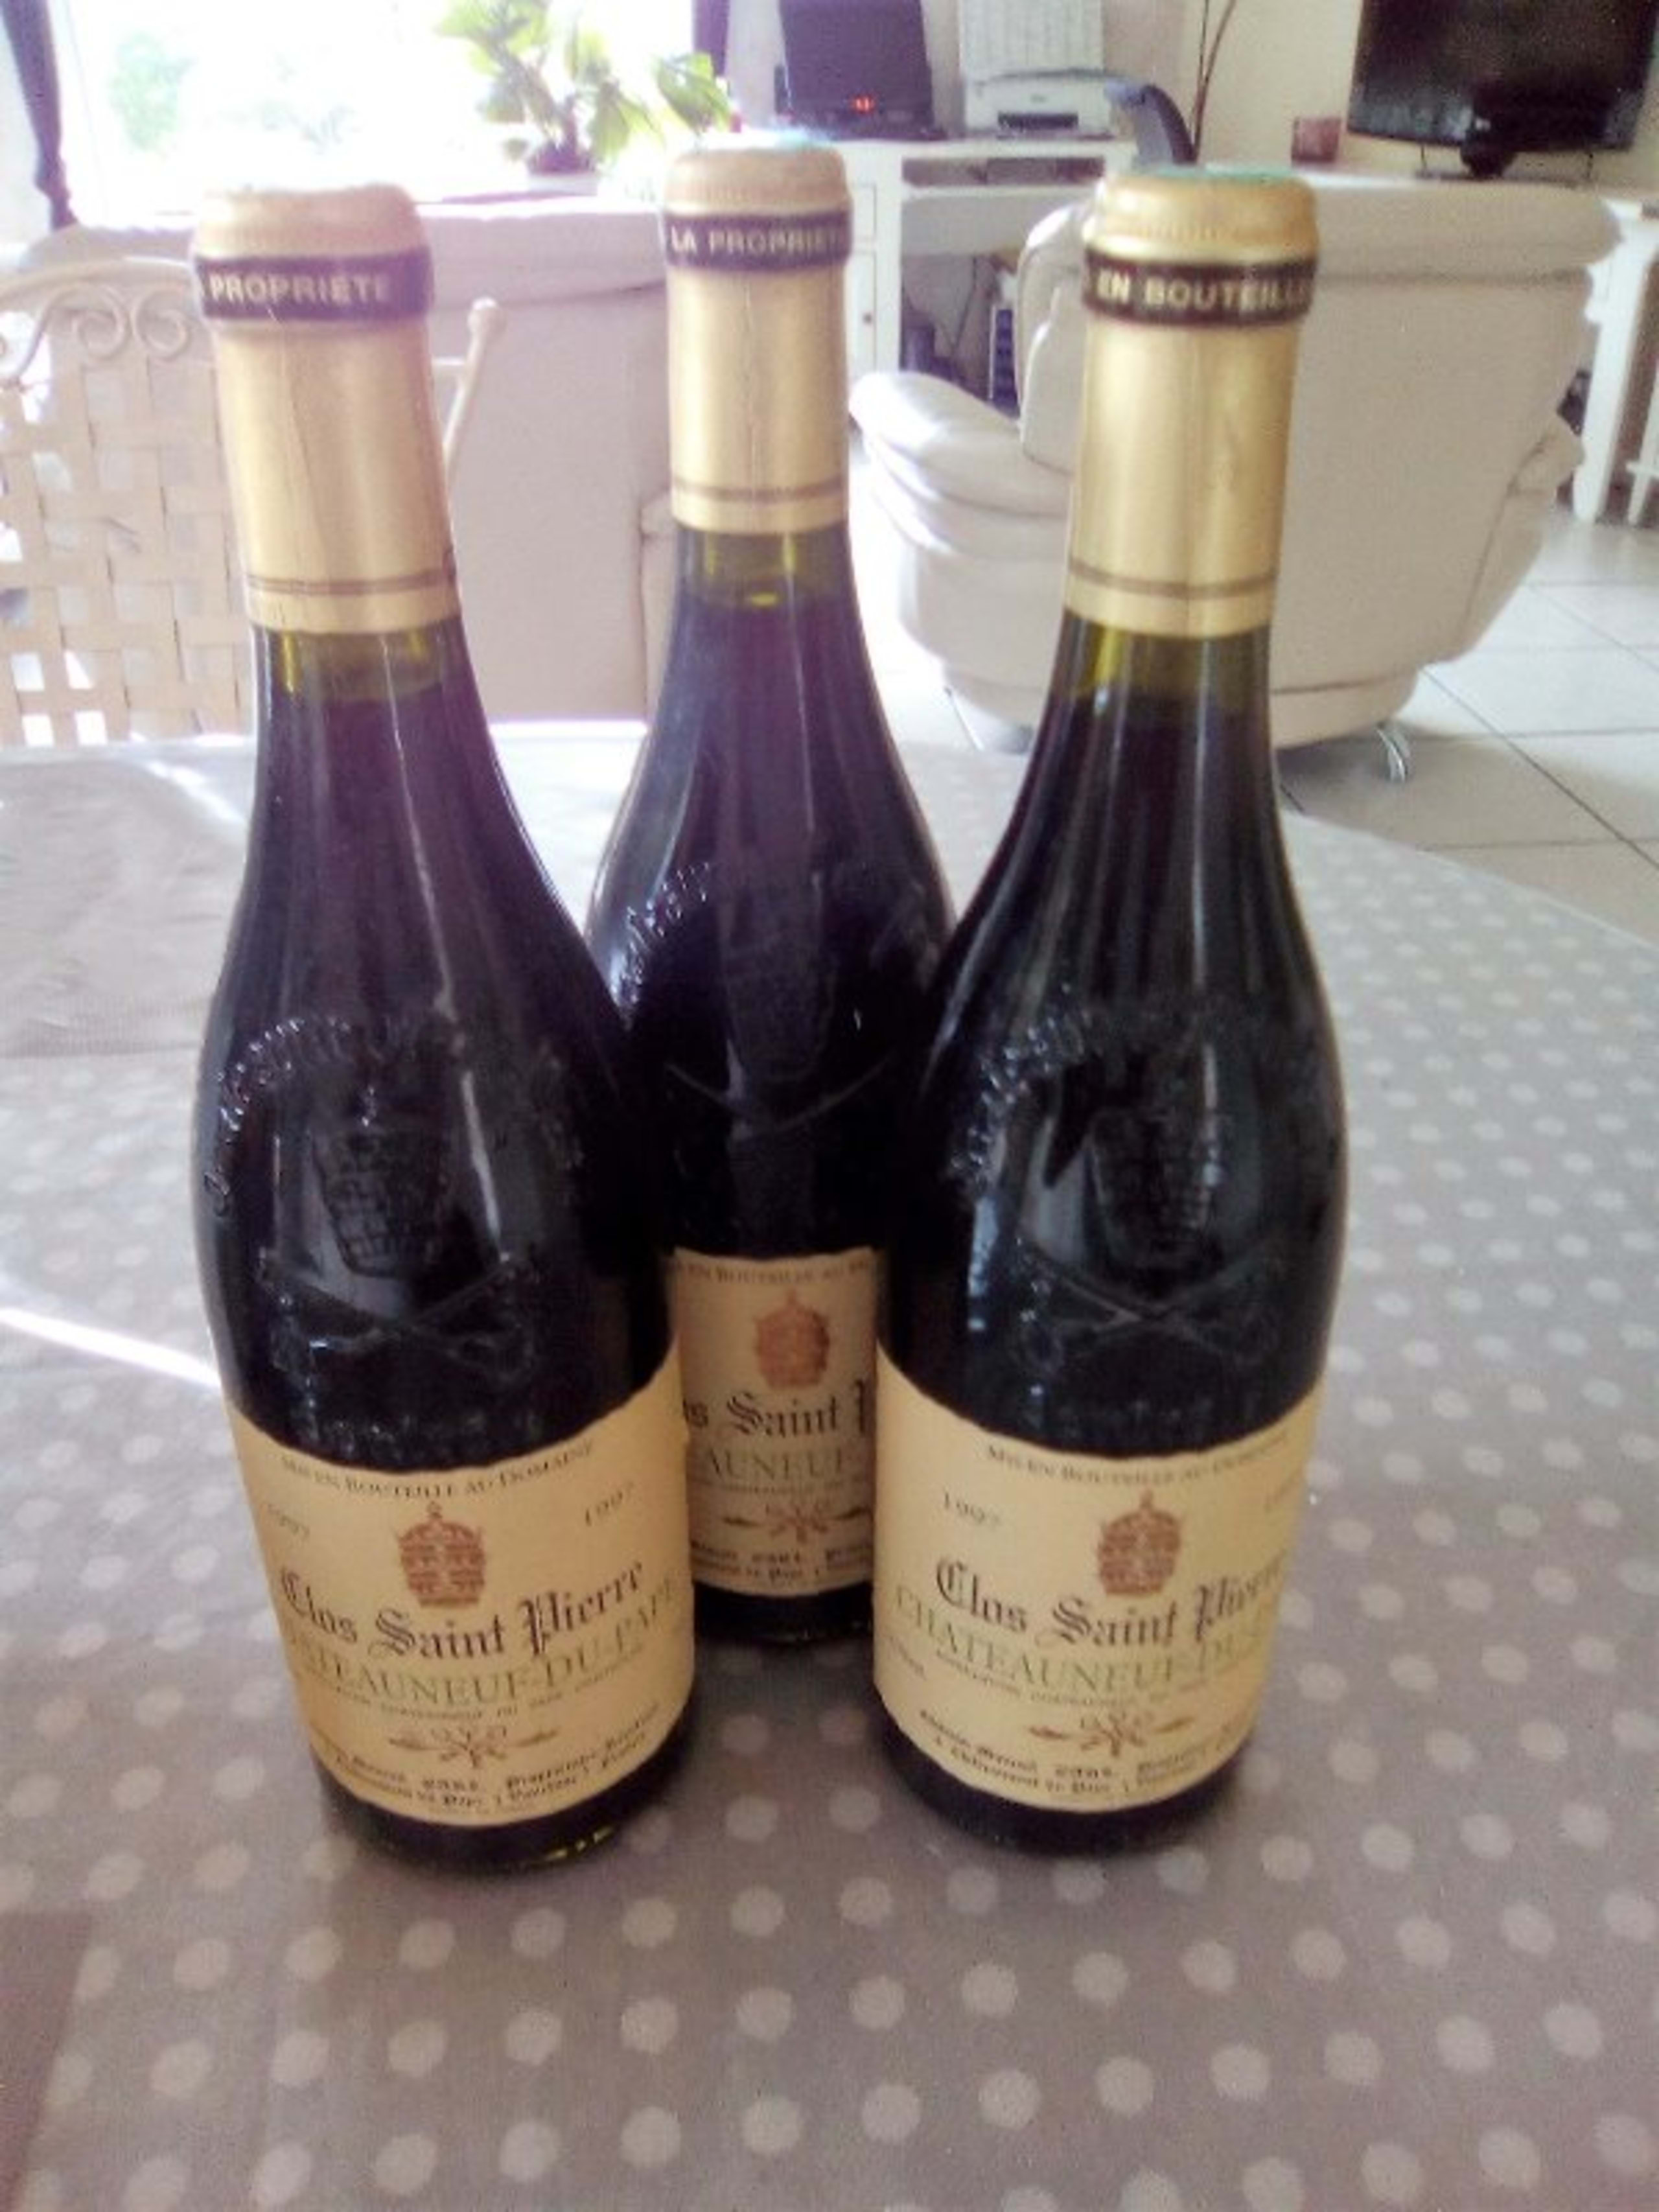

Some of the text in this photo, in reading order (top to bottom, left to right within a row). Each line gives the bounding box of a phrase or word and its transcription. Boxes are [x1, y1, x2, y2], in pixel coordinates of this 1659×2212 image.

[670, 224, 699, 255] LA
[1096, 268, 1131, 304] EN
[721, 1390, 839, 1438] Saint
[280, 1560, 643, 1660] Clos Saint Pierre
[935, 1557, 1028, 1634] Clos
[1042, 1593, 1177, 1649] Saint
